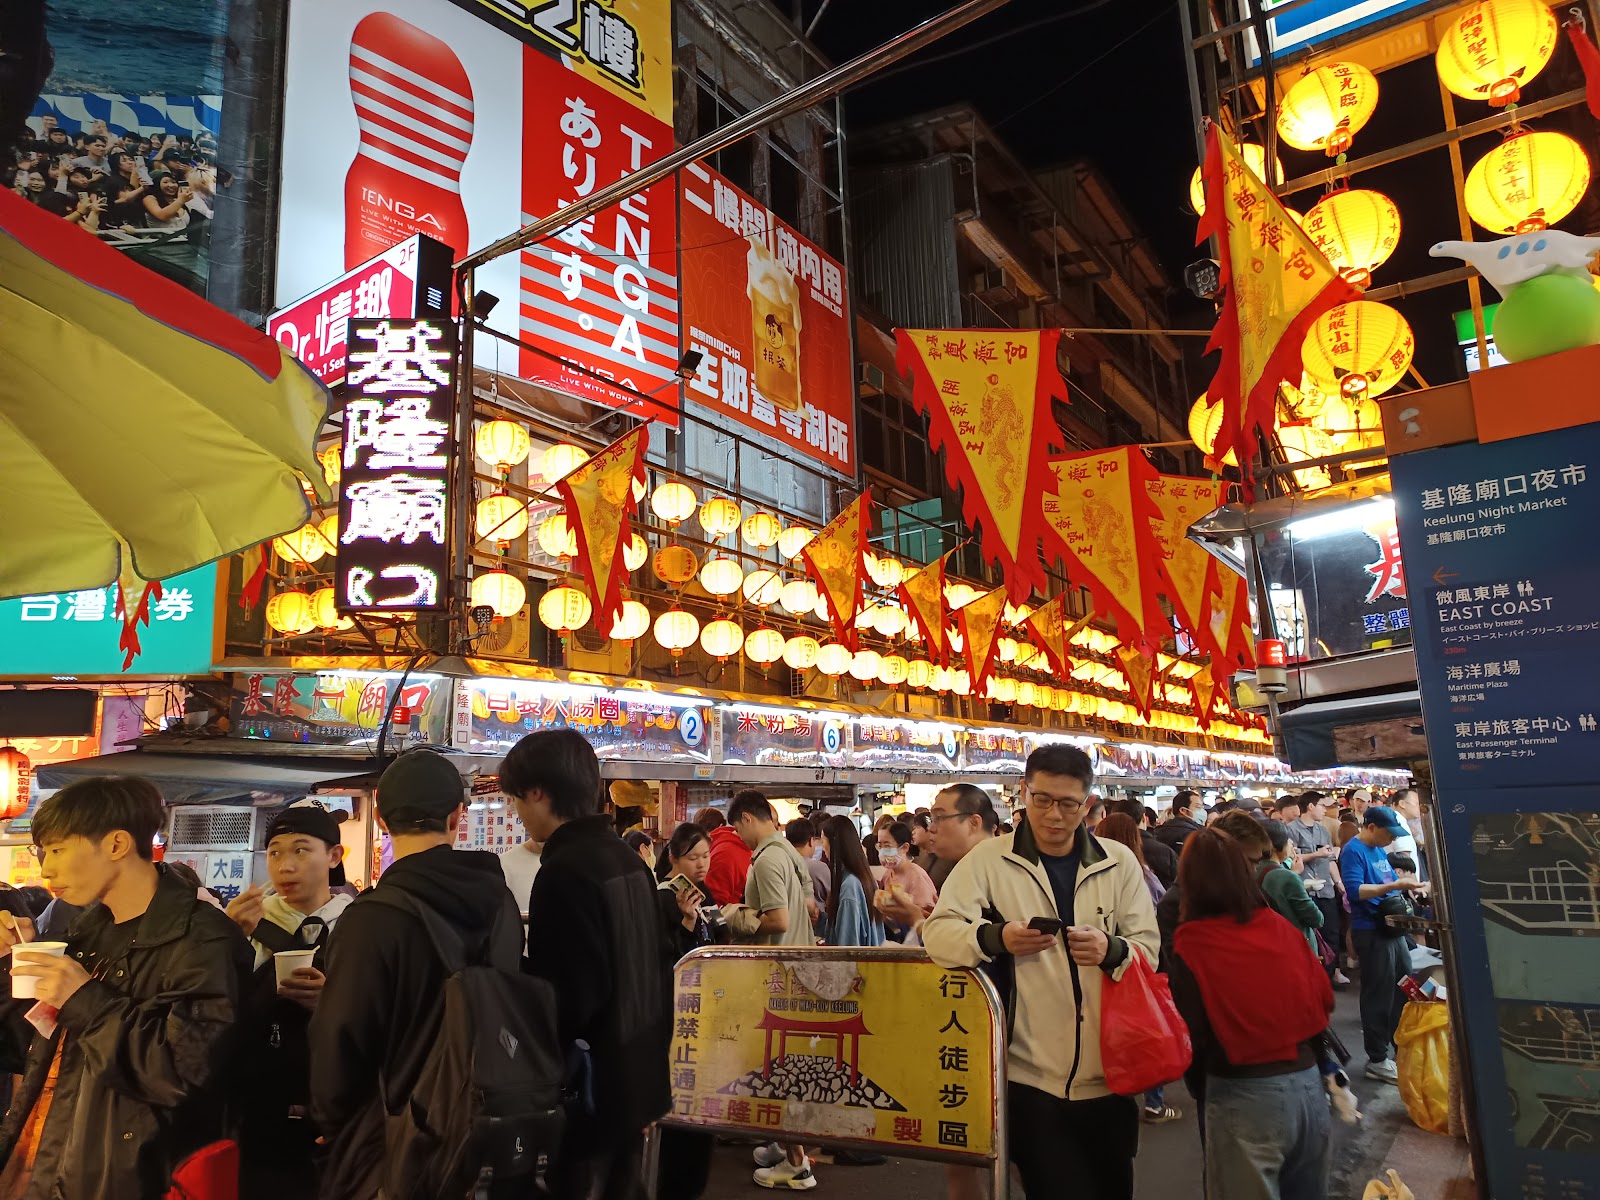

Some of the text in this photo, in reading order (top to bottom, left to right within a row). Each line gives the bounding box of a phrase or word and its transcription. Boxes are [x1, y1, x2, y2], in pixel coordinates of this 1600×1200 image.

[360, 205, 379, 217] LIVE
[382, 212, 404, 227] WITH
[361, 186, 444, 231] TENGA
[399, 242, 416, 266] 2F
[560, 374, 580, 387] LIVE
[583, 381, 606, 395] WITH
[1421, 463, 1588, 511] 基隆廟口夜市
[1423, 496, 1568, 527] Keelung Night Market
[1426, 523, 1506, 546] 基隆廟口夜市
[1435, 583, 1511, 606] 微風東岸
[1438, 597, 1554, 622] EAST COAST
[1440, 618, 1524, 633] East Coast by breeze
[1445, 659, 1521, 681] 海洋廣場
[240, 673, 301, 717] 基隆
[1448, 680, 1509, 692] Maritime Plaza
[687, 716, 697, 740] 2
[738, 711, 812, 737] 米粉湯
[1454, 716, 1572, 738] 東岸旅客中心
[827, 729, 836, 749] 6
[1456, 736, 1558, 749] East Passenger Terminal
[1458, 749, 1536, 761] 東岸旅客ターミナル
[213, 859, 245, 879] 大腸
[831, 1001, 859, 1015] KEELUNG
[671, 968, 702, 1117] 車輛禁止通行
[937, 973, 970, 1149] 行人徒步區
[701, 1095, 782, 1126] 基隆市
[893, 1115, 923, 1143] 製
